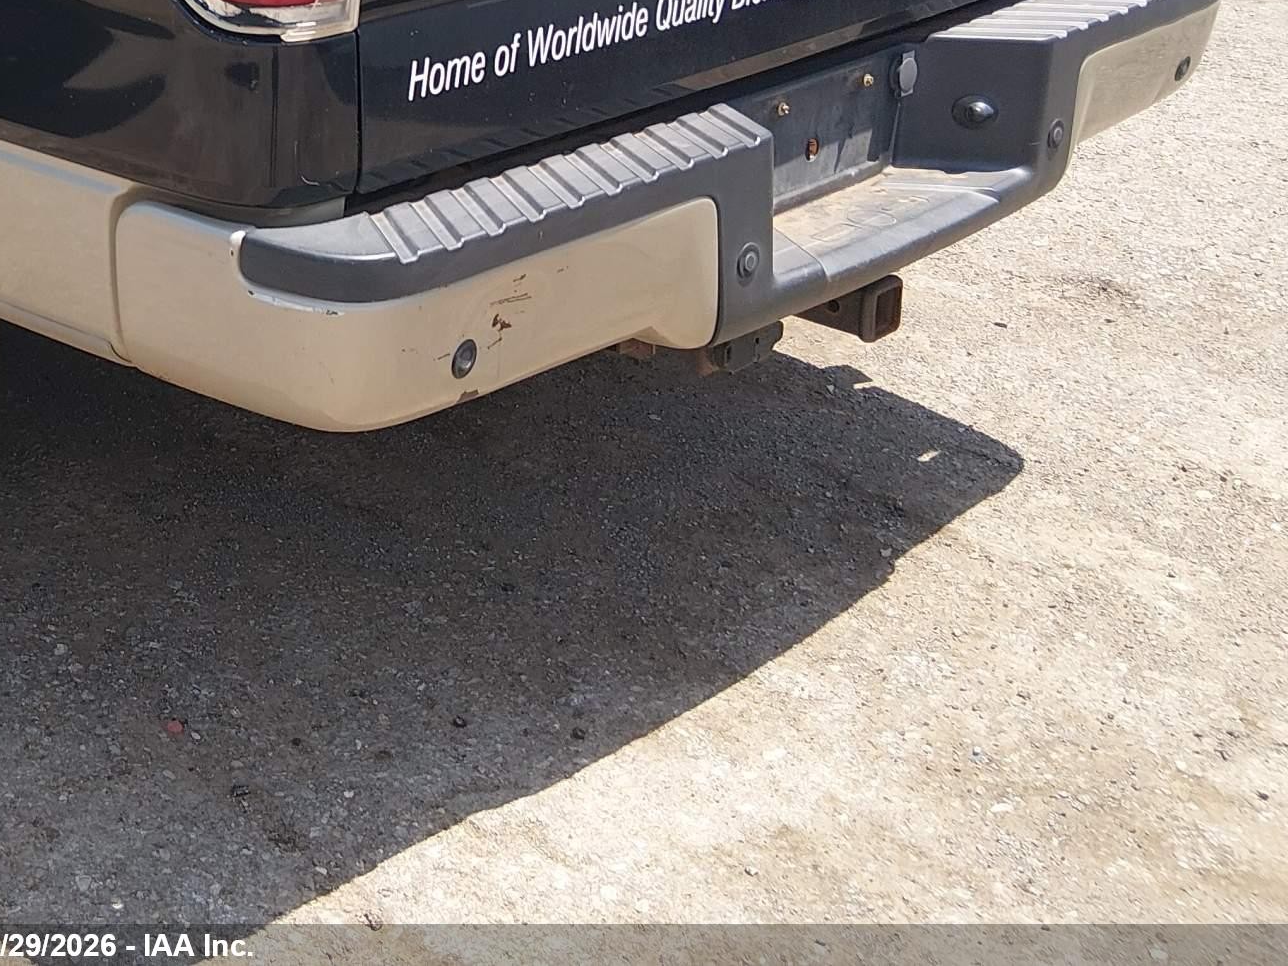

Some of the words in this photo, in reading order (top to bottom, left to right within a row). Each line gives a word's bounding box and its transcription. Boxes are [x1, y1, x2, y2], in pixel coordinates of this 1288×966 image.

[407, 51, 486, 101] Home
[494, 33, 521, 76] of
[527, 2, 649, 66] Worldwide
